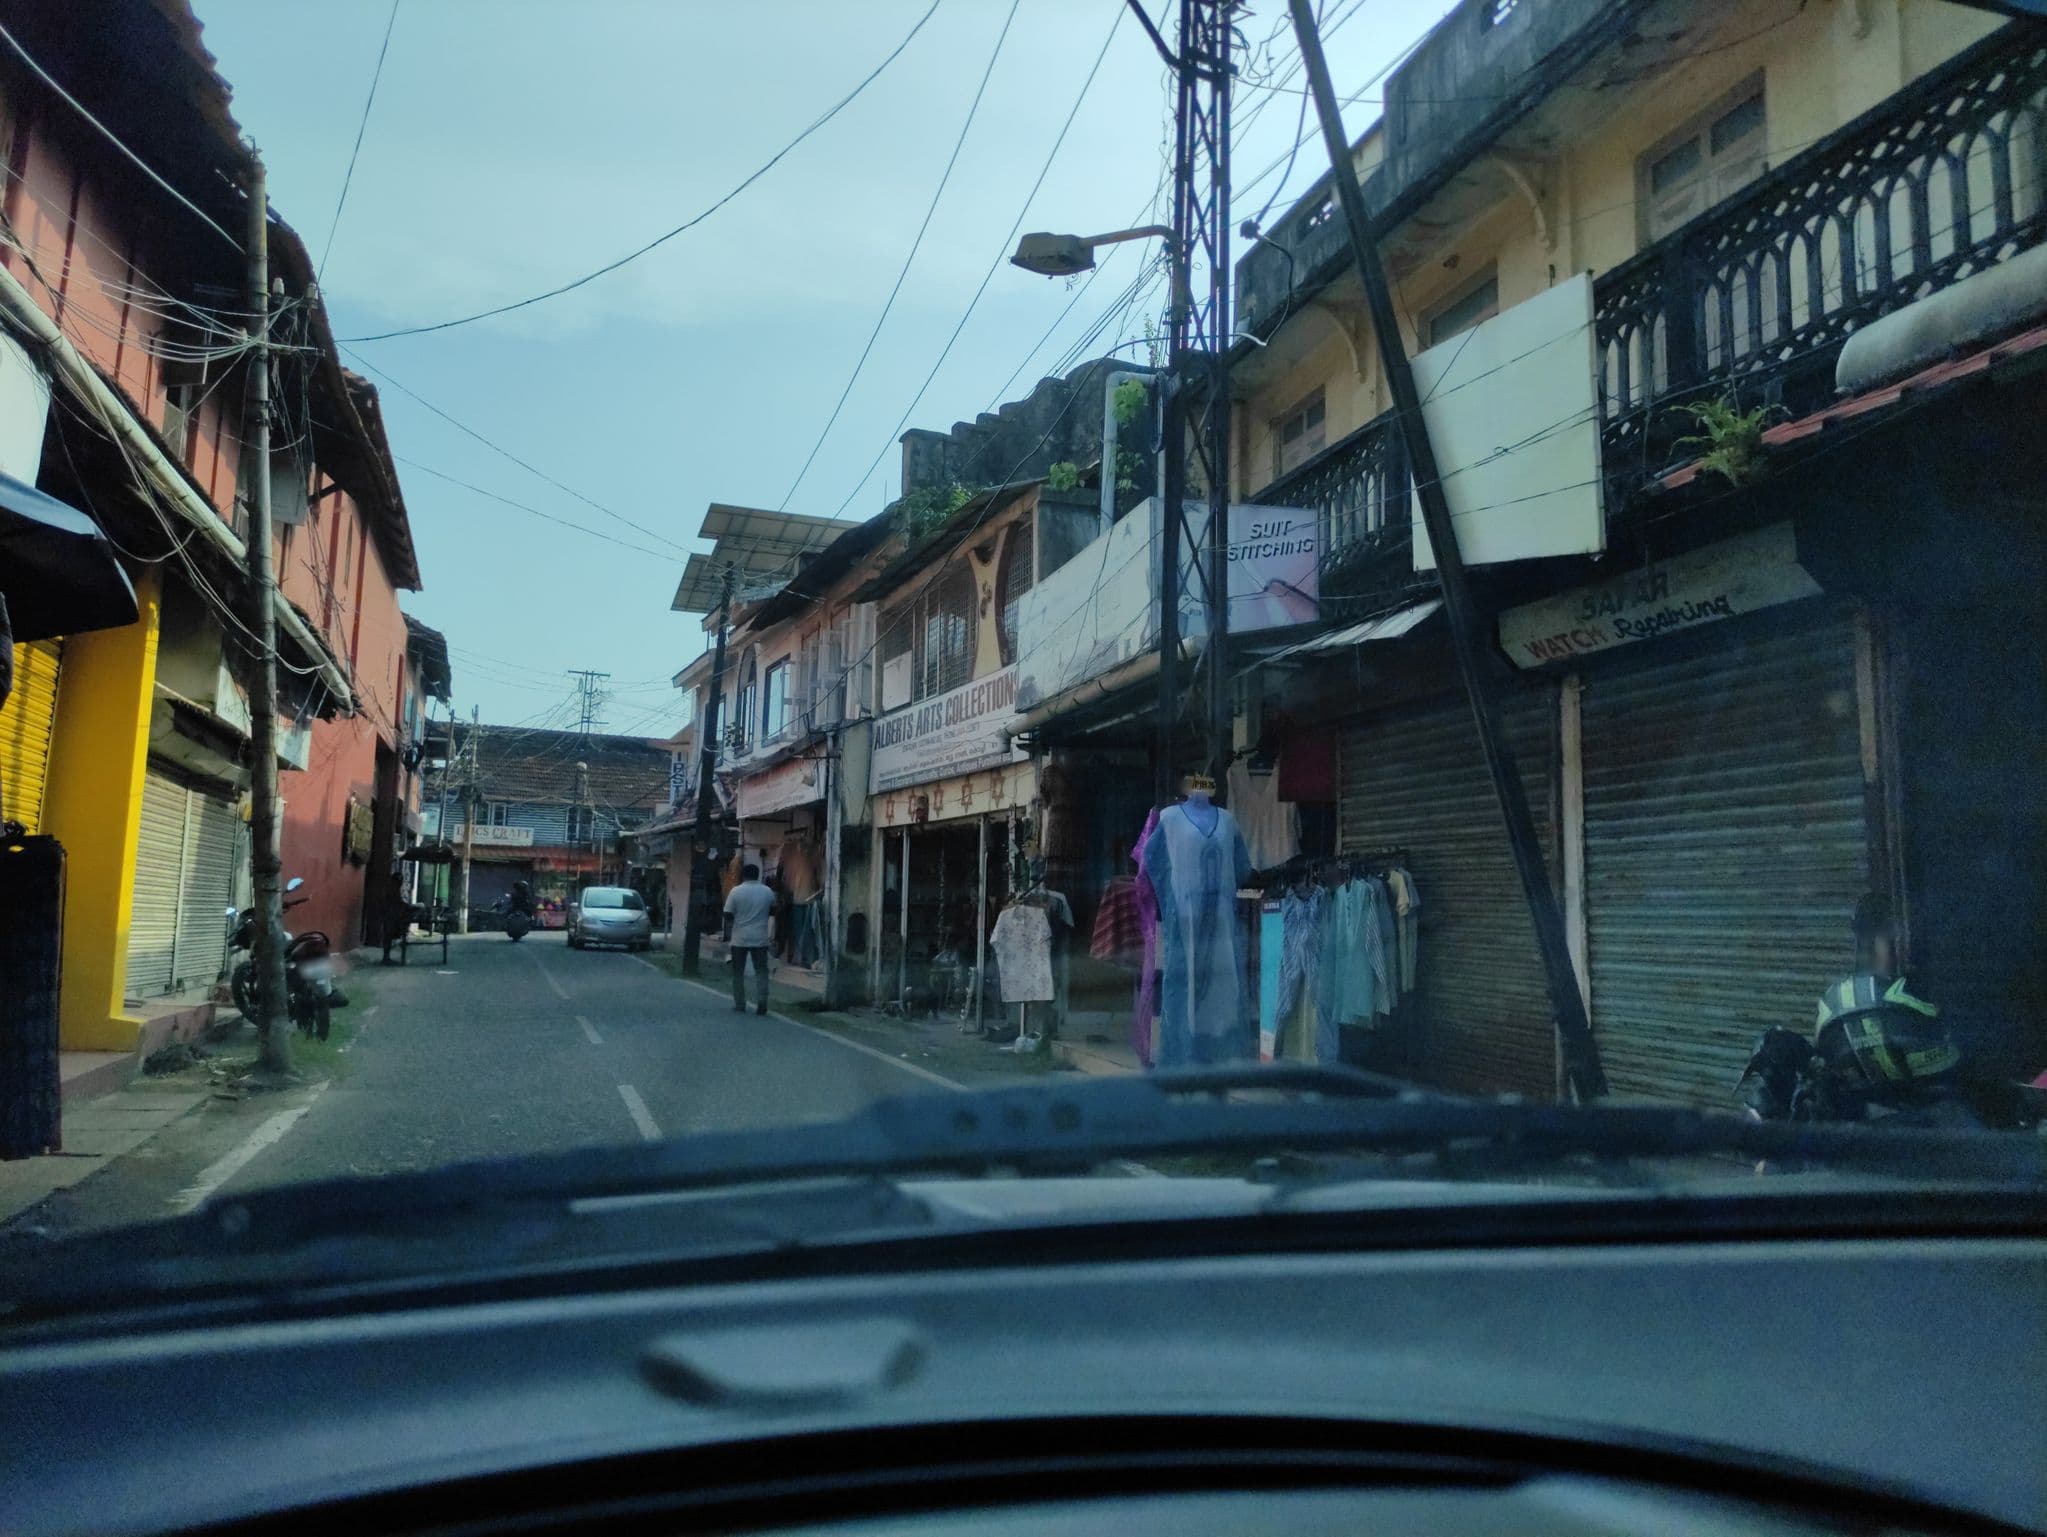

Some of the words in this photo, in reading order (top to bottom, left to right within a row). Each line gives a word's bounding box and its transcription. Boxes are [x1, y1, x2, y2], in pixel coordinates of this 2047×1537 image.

[1251, 520, 1293, 539] SUIT
[1227, 538, 1315, 561] STITCHING
[1525, 626, 1609, 660] WATCH
[874, 713, 914, 750] ALBERTS
[916, 702, 943, 737] ARTS
